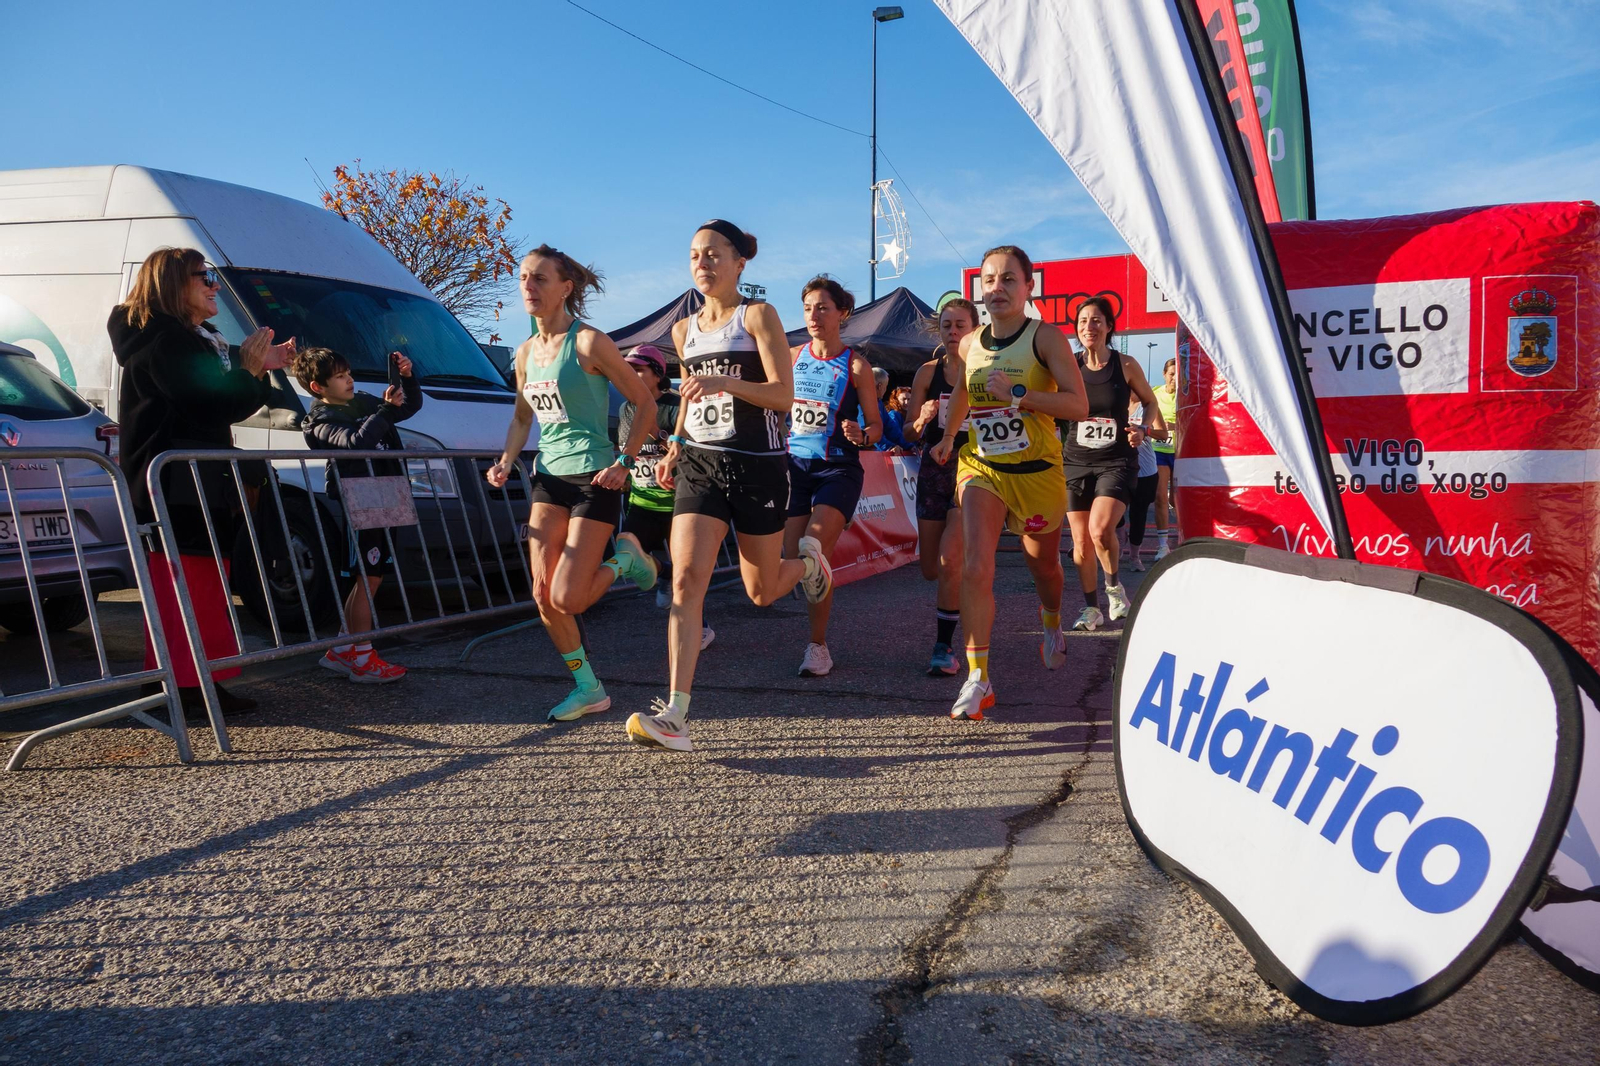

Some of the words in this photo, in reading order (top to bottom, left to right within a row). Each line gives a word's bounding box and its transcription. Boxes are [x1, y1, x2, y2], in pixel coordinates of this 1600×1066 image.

[1327, 342, 1422, 372] VIGO
[794, 380, 822, 388] CONCELLO
[531, 392, 563, 411] 201
[692, 401, 734, 426] 205
[795, 407, 828, 427] 202
[979, 418, 1025, 442] 209
[1084, 425, 1114, 440] 214
[1344, 438, 1434, 471] VIGO,
[634, 463, 656, 478] 20
[1380, 467, 1419, 494] de
[1430, 471, 1508, 499] xogo
[31, 516, 71, 538] HWD
[1424, 522, 1533, 558] nunha
[1128, 650, 1492, 915] Atlántico
